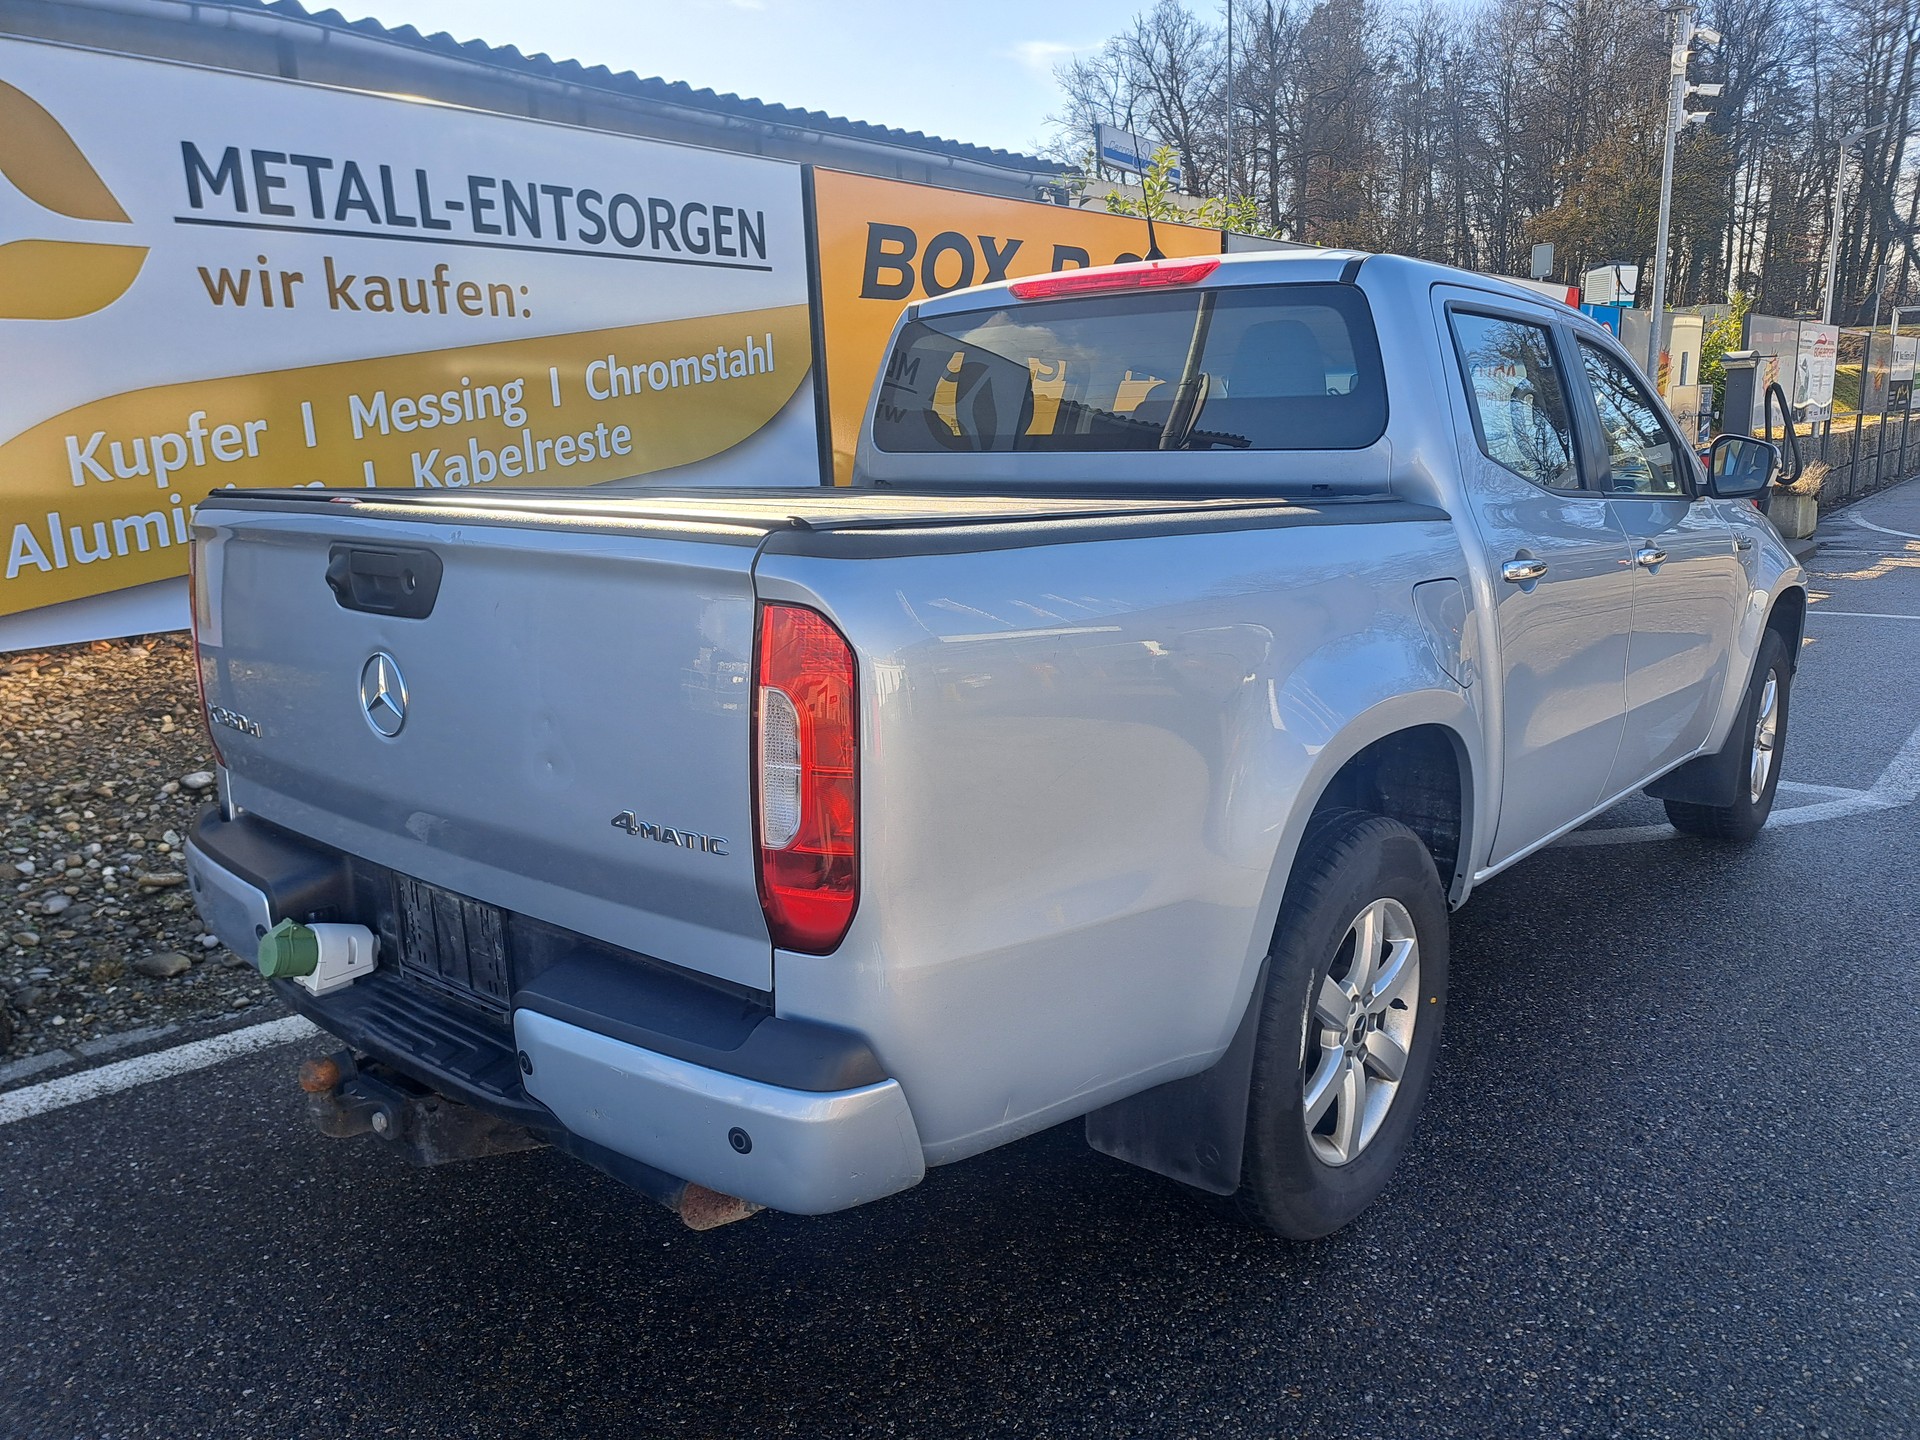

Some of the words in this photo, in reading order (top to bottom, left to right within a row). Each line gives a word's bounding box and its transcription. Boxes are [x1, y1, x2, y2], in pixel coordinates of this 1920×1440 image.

[181, 140, 766, 260] METALL-ENTSORGEN
[198, 254, 304, 308] wir
[323, 256, 532, 318] kaufen:
[858, 221, 1024, 301] BOX
[65, 410, 268, 489] Kupfer
[349, 376, 528, 440] Messing
[585, 332, 774, 401] Chromstahl
[5, 482, 326, 579] Alumi
[411, 422, 633, 488] Kabelreste
[610, 809, 730, 856] 4MATIC
